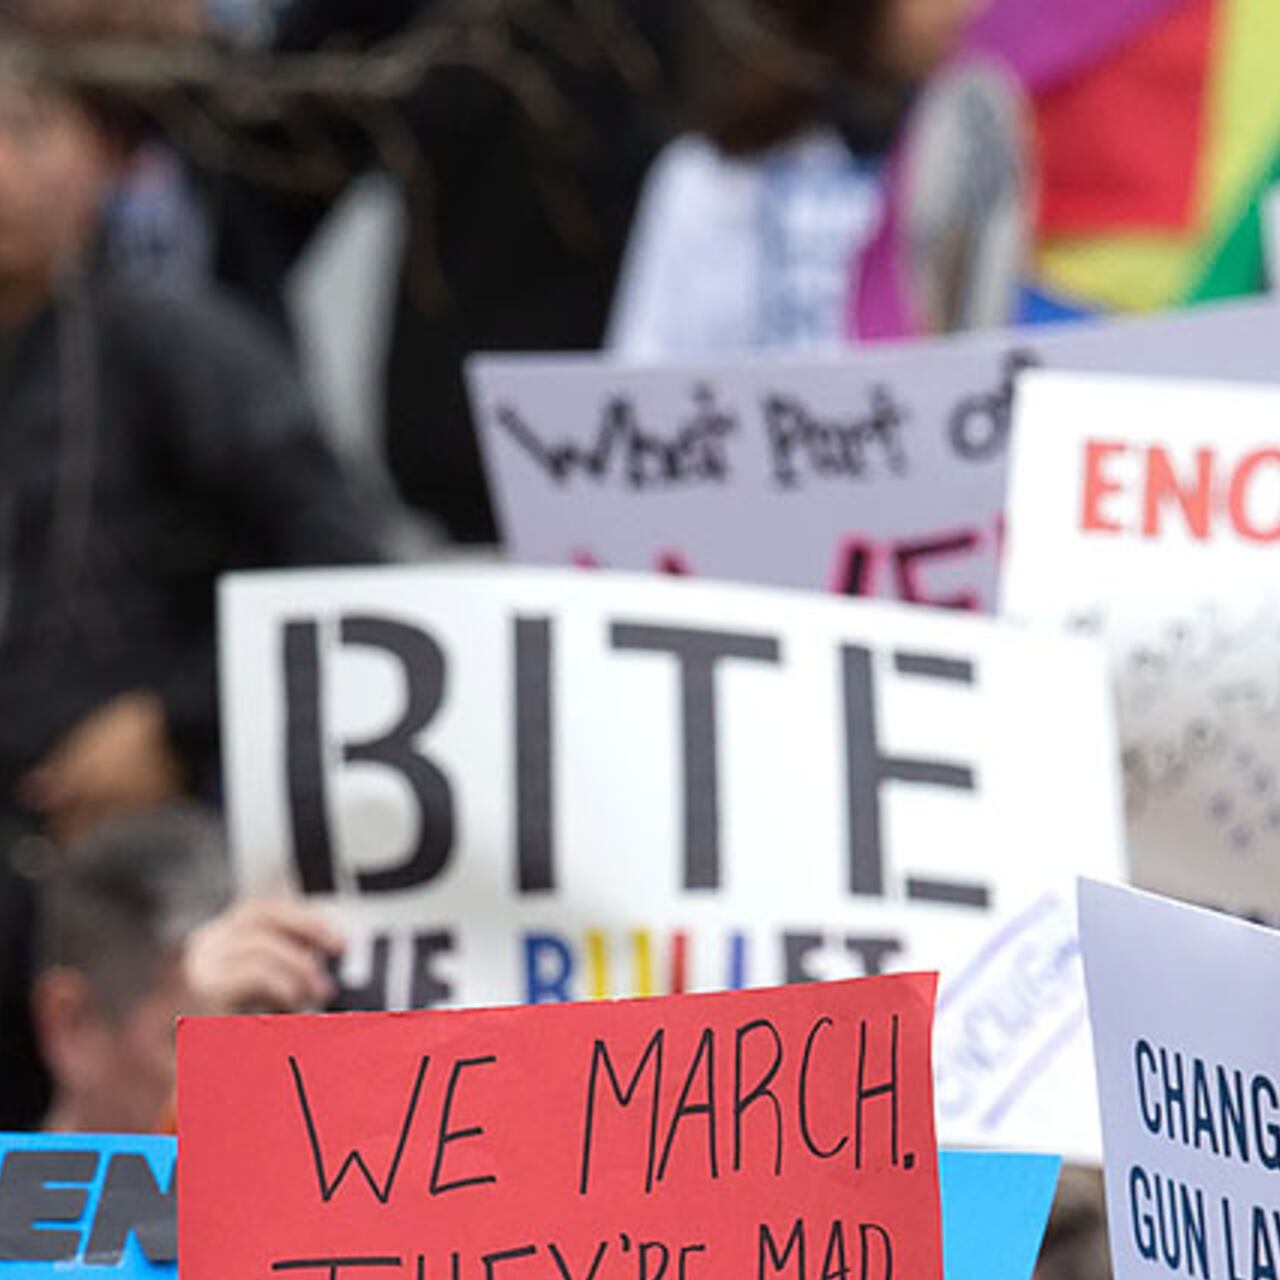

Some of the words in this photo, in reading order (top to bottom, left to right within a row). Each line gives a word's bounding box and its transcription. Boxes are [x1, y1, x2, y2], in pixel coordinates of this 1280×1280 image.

[497, 378, 738, 490] What
[763, 378, 913, 488] Part
[280, 613, 995, 911] BITE
[288, 1053, 497, 1204] WE
[578, 1013, 918, 1196] MARCH.
